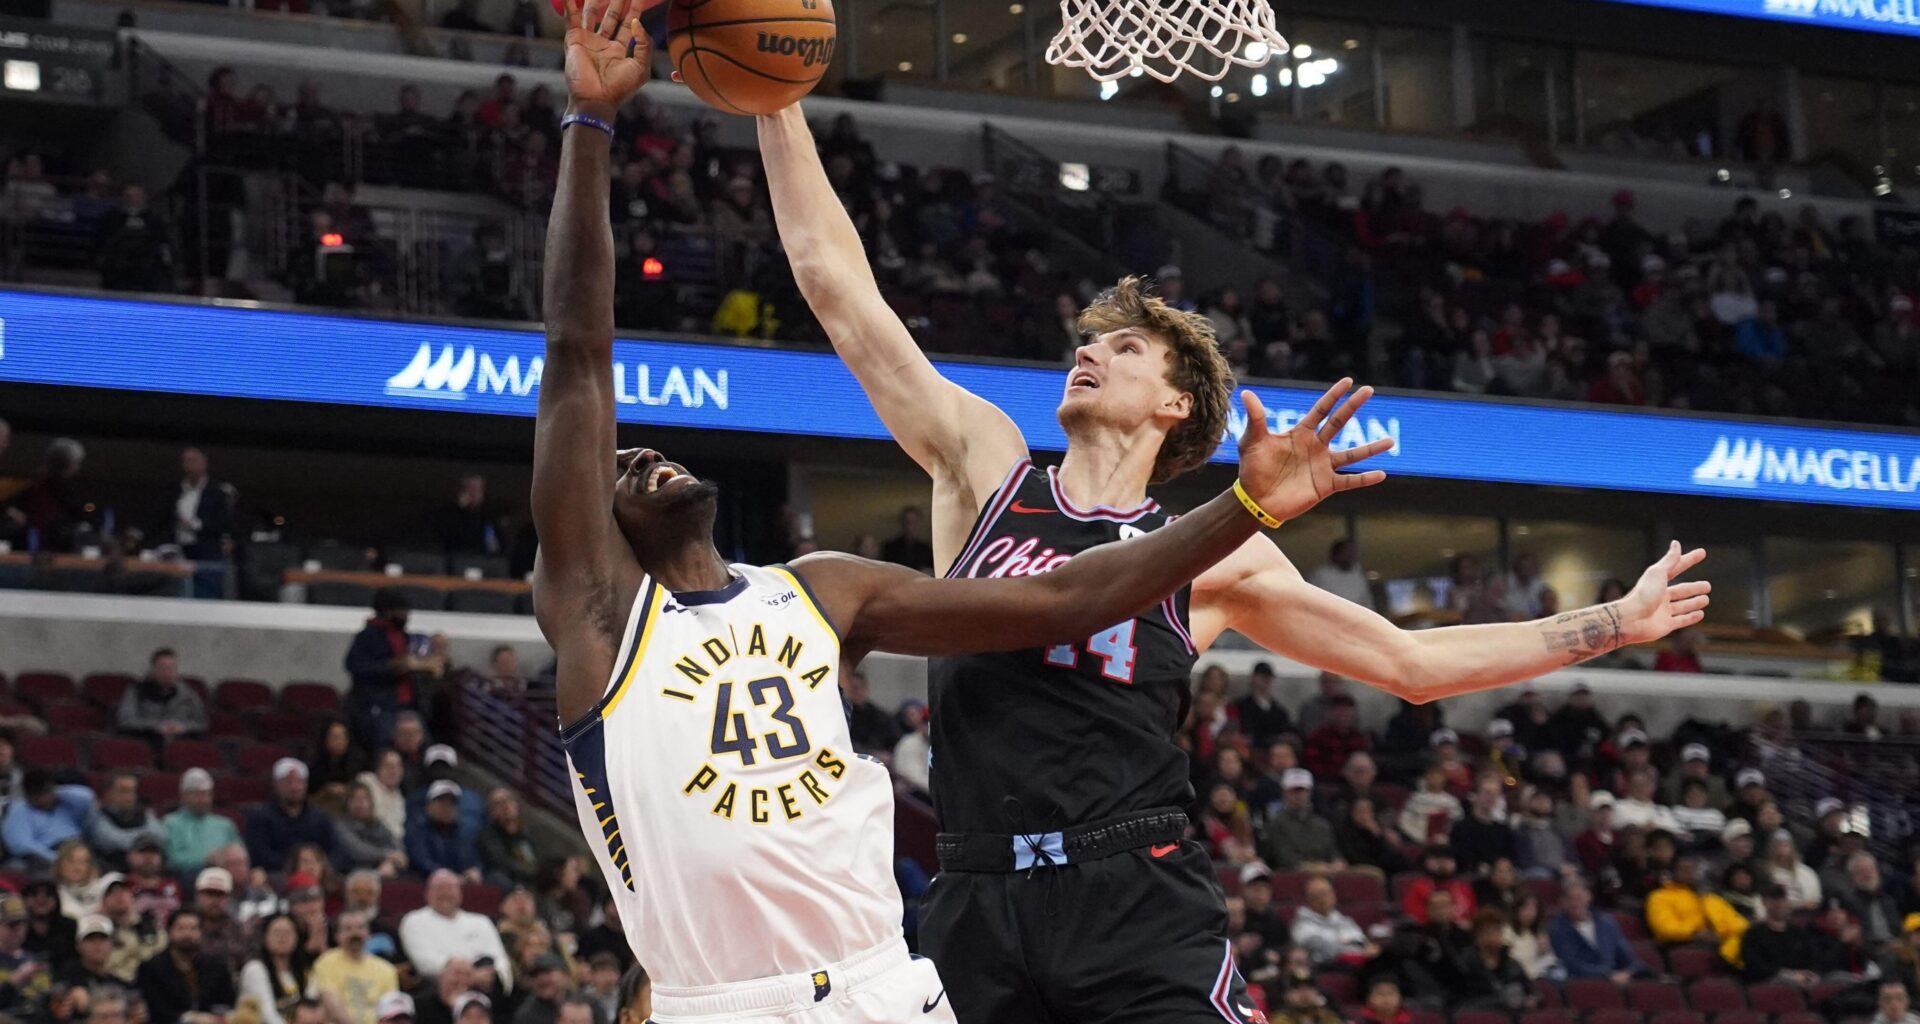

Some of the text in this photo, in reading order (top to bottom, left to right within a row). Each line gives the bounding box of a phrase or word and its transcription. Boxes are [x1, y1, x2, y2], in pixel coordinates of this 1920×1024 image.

[476, 352, 728, 410] MALLAN
[781, 590, 798, 603] OIL
[662, 623, 831, 702] INDIANA
[710, 675, 811, 766] 43
[682, 747, 847, 824] PACERS
